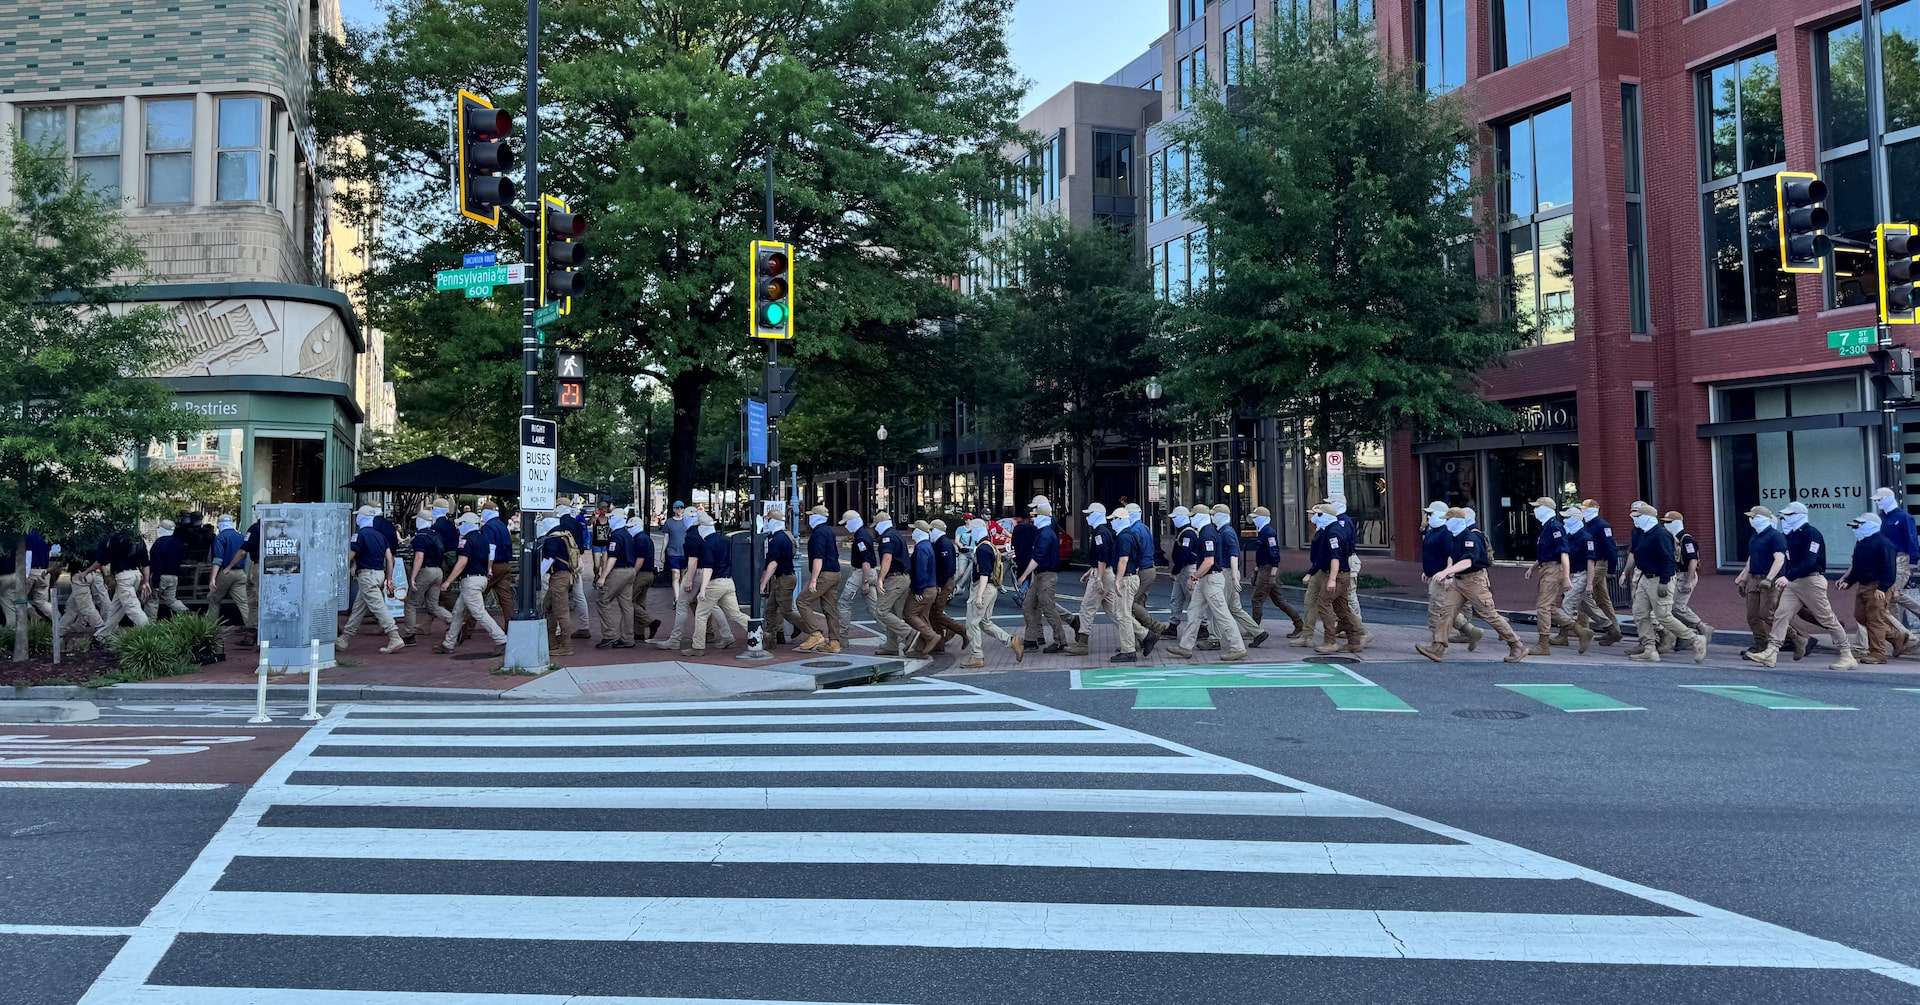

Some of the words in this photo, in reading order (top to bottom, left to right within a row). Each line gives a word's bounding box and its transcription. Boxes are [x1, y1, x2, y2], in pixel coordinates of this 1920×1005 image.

[437, 270, 496, 288] Pennsylvania
[469, 285, 489, 296] 600
[1839, 332, 1850, 346] 7
[1839, 345, 1867, 356] 2-300
[561, 383, 580, 405] 23
[185, 400, 238, 415] Pastries
[530, 424, 546, 434] RIGHT
[531, 435, 546, 445] LANE
[526, 452, 551, 466] BUSES
[528, 468, 549, 481] ONLY
[1762, 486, 1830, 499] SEPORA
[1834, 486, 1862, 498] STU
[266, 539, 298, 548] MERCY
[275, 547, 297, 555] HERE
